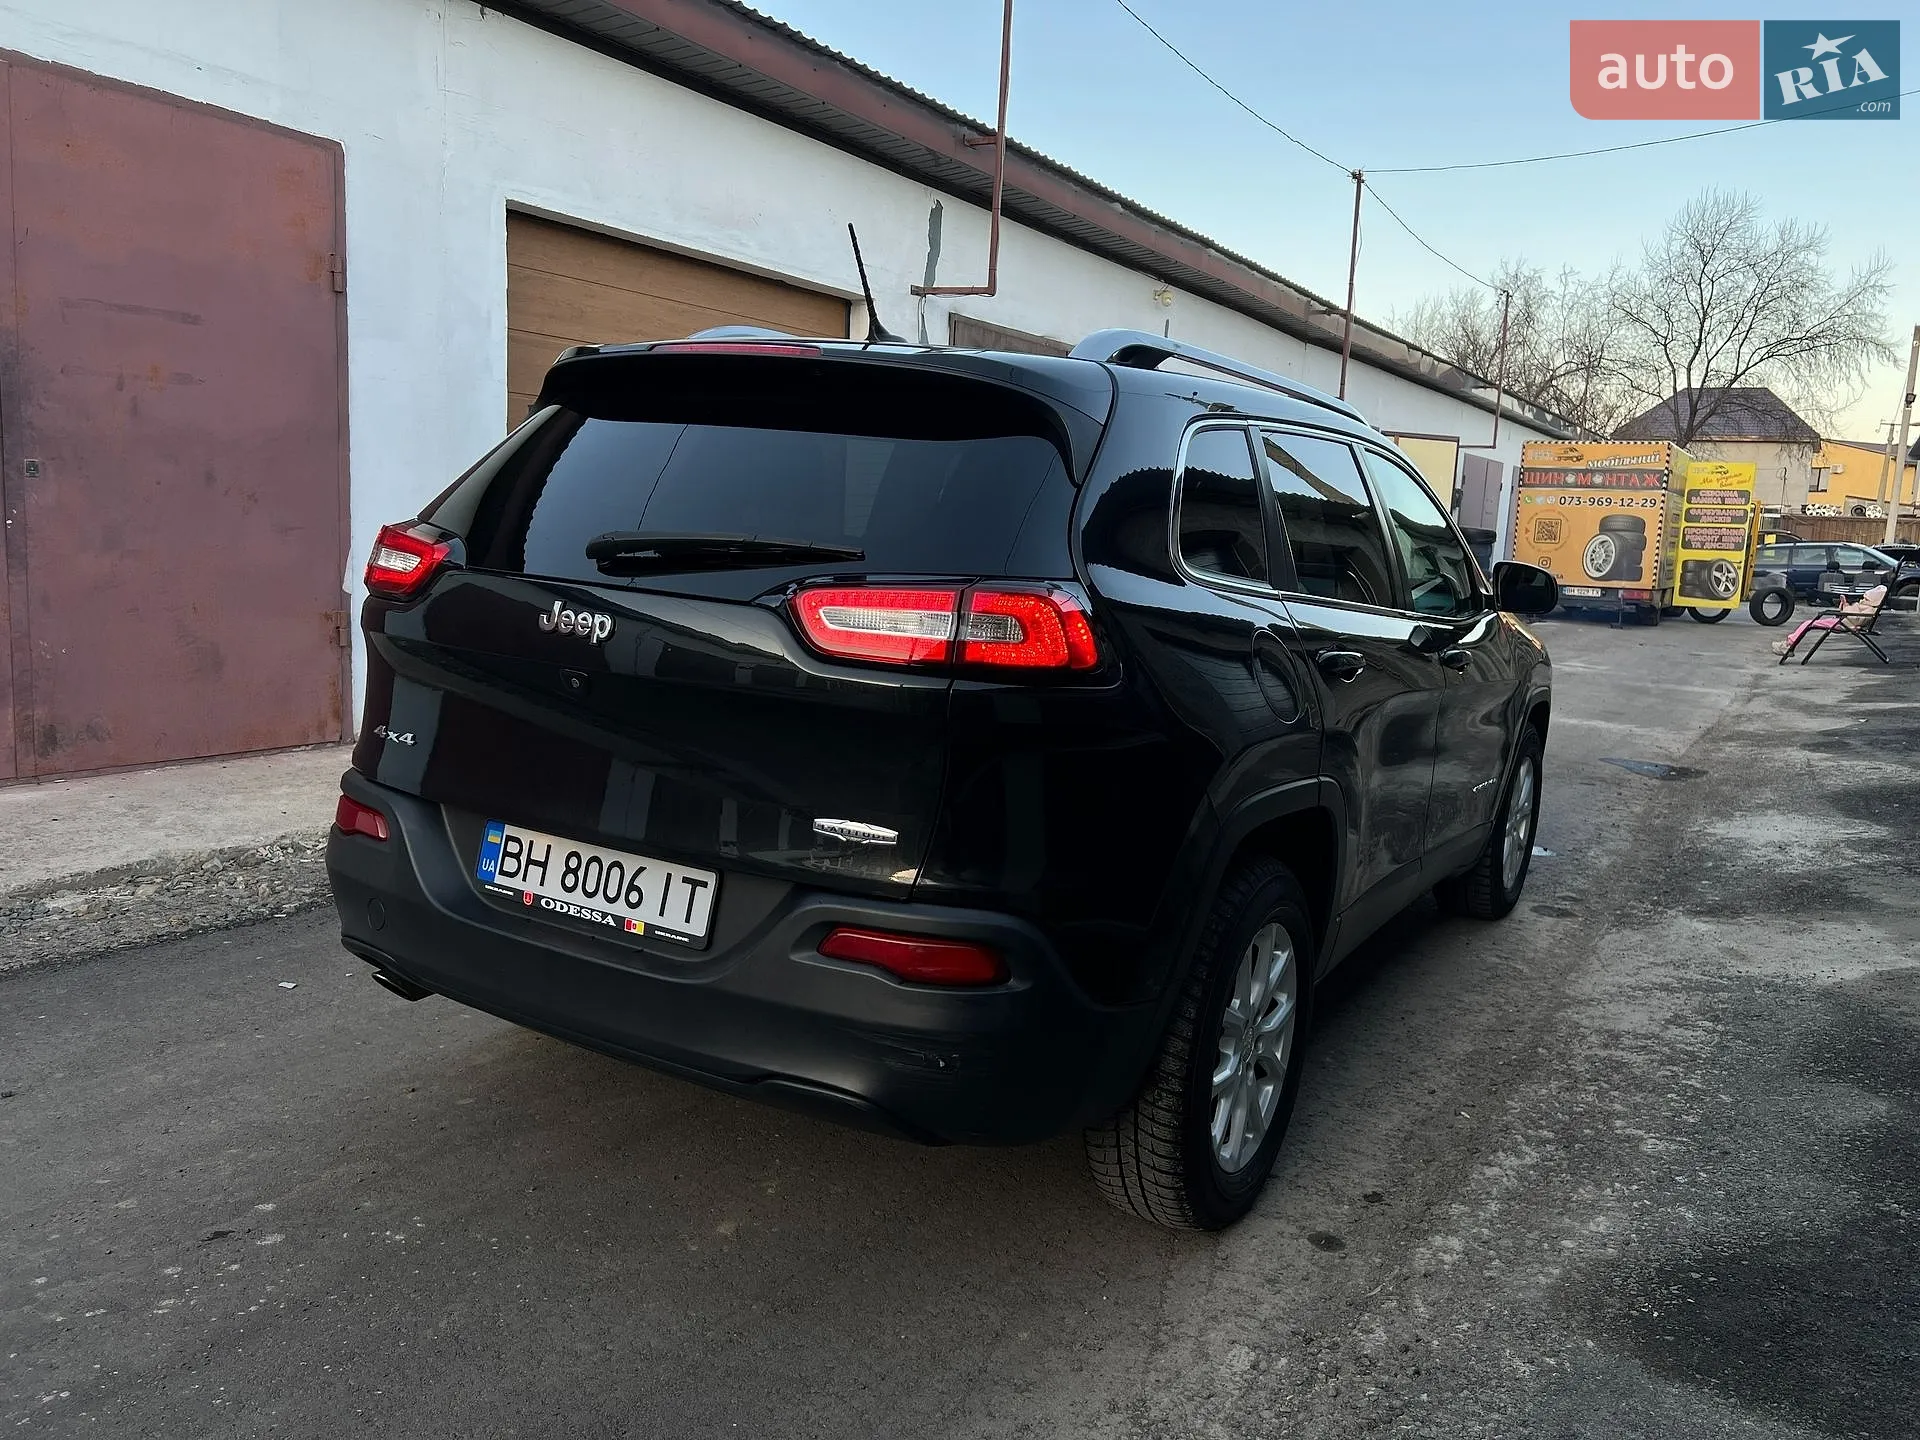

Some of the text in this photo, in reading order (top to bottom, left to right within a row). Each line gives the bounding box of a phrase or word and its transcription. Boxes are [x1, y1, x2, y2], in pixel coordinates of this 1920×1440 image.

[1559, 496, 1657, 508] 073-969-12-29
[538, 600, 614, 644] Jeep
[374, 725, 415, 745] 4x4
[482, 858, 495, 873] UA
[498, 835, 709, 924] BH 8006 IT
[540, 898, 617, 927] ODESSA
